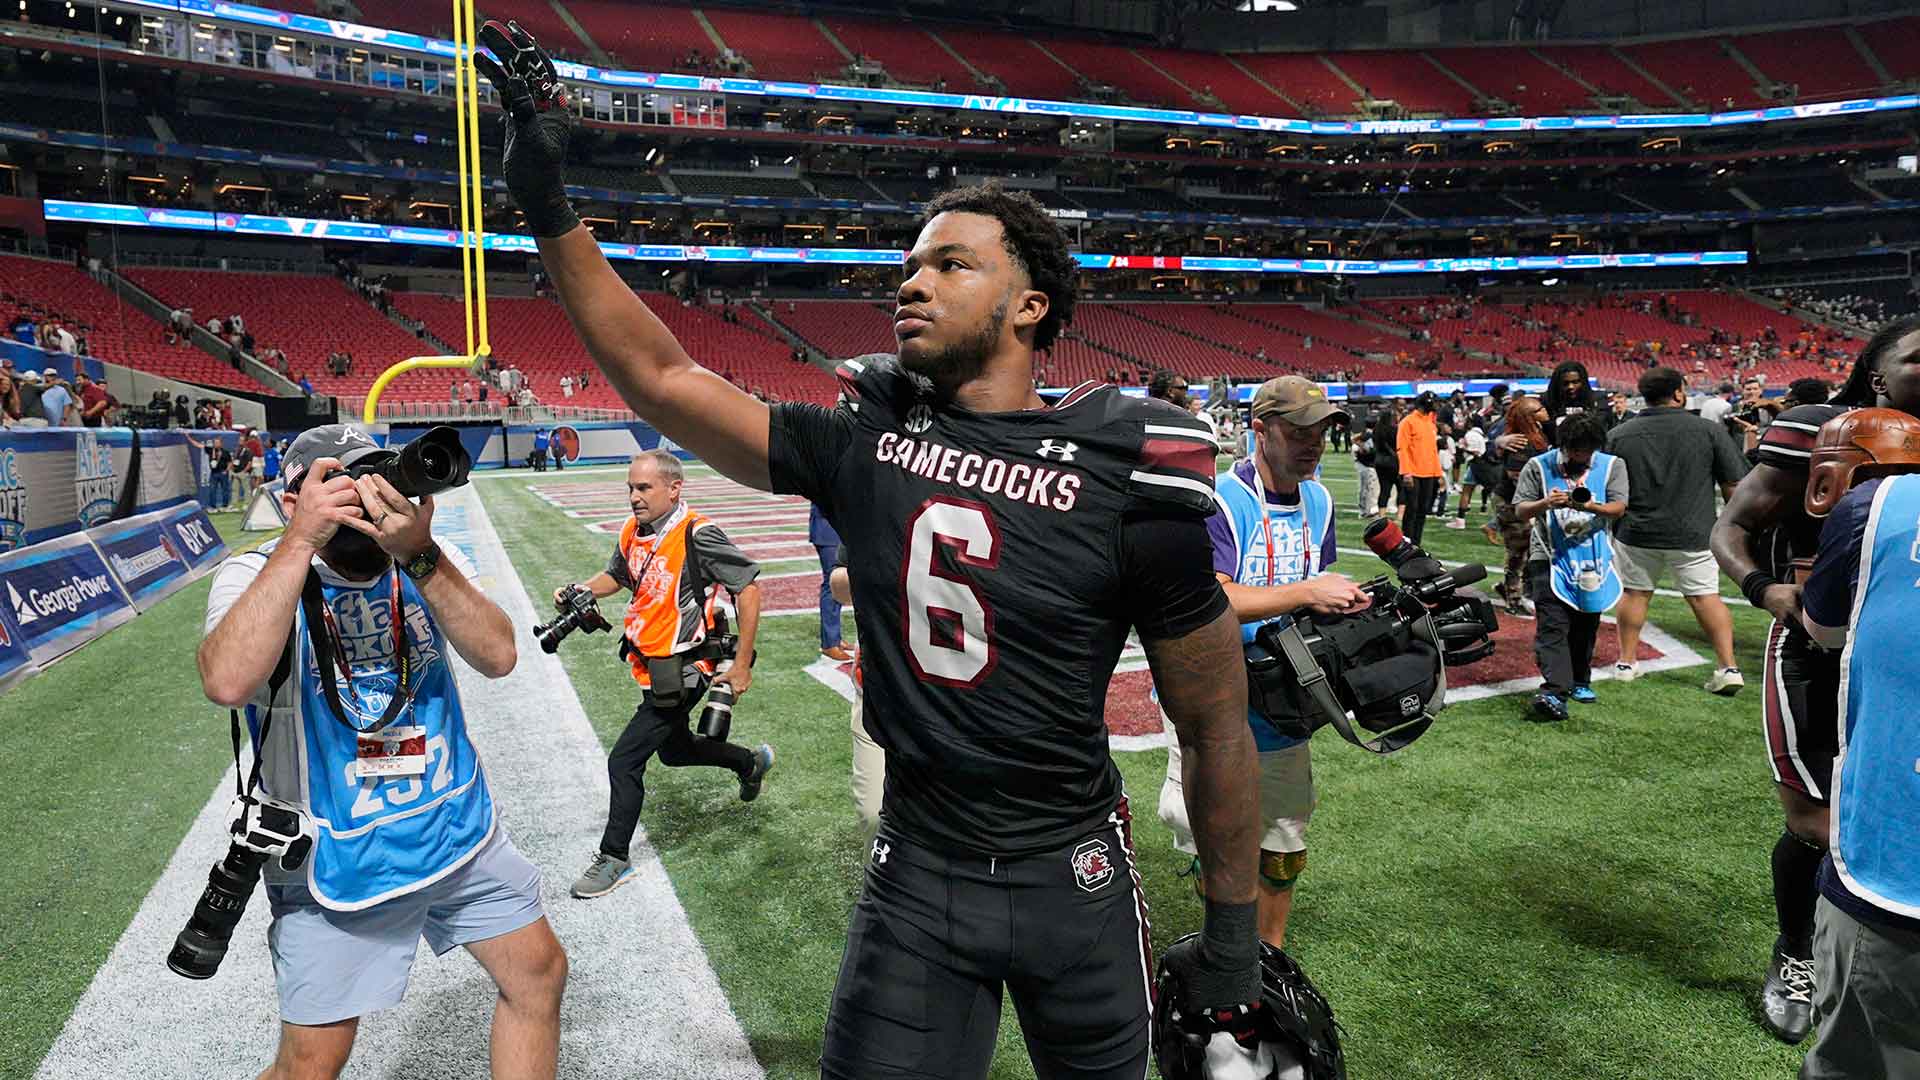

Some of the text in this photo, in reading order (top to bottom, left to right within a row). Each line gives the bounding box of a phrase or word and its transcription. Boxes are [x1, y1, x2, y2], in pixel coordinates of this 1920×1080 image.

[875, 431, 1081, 513] GAMECOCKS
[29, 575, 112, 617] Georgia Power
[904, 497, 1002, 687] 6
